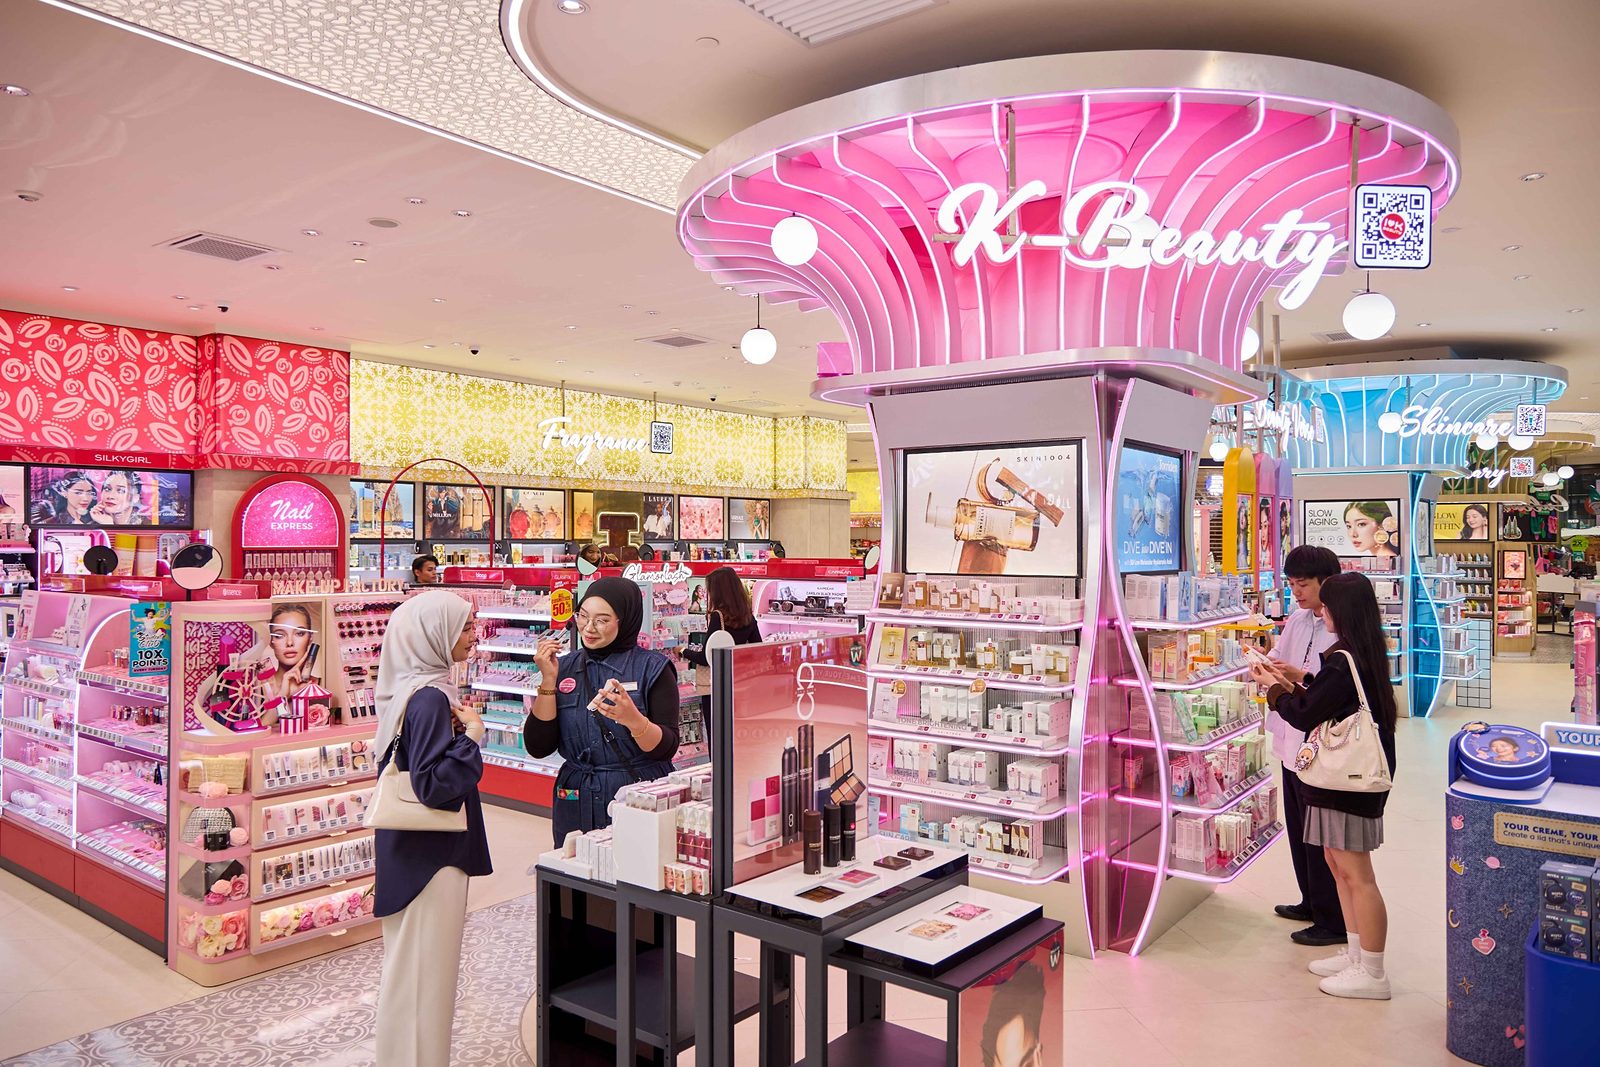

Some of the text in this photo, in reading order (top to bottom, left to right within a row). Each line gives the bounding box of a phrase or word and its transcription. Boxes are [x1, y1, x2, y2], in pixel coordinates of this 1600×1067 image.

[936, 180, 1350, 311] K-Beauty
[1399, 405, 1514, 437] Skincare
[538, 417, 648, 464] Fragrance
[94, 453, 152, 464] SILKYGIRL
[1016, 454, 1071, 463] SKIN1004
[270, 499, 314, 521] Nail
[1308, 509, 1333, 518] SLOW
[271, 522, 313, 530] EXPRESS
[1308, 518, 1339, 526] AGING
[1123, 541, 1141, 554] DIVE
[1149, 541, 1165, 554] DIVE
[222, 588, 242, 597] essence
[272, 577, 405, 595] MAKE UP FACTORY
[553, 602, 565, 617] 50
[137, 649, 164, 660] 10X
[132, 658, 168, 668] POINTS
[898, 717, 967, 731] TONE BRIGHTENING
[1503, 822, 1598, 842] YOUR CREME, YOUR
[1503, 830, 1528, 839] Create
[1537, 833, 1547, 842] lid
[1548, 836, 1571, 845] that's
